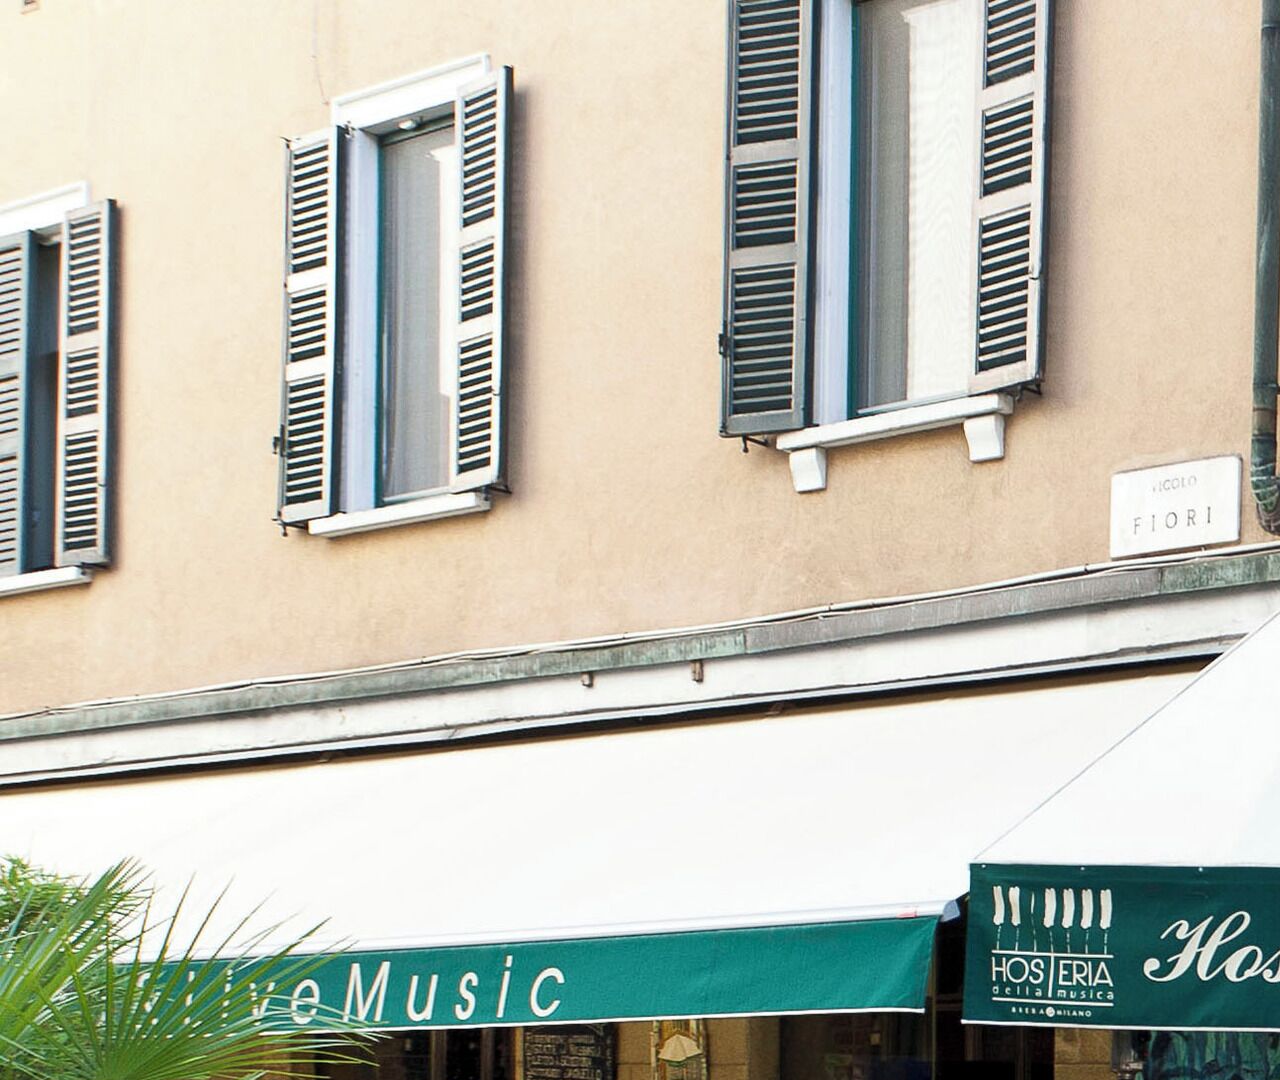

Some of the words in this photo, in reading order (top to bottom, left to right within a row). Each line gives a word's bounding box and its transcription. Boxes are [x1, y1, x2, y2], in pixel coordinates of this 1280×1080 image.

[1132, 505, 1212, 535] FIORI
[991, 955, 1114, 992] HOSTERIA
[992, 985, 1043, 997] della
[1057, 989, 1115, 1001] musica
